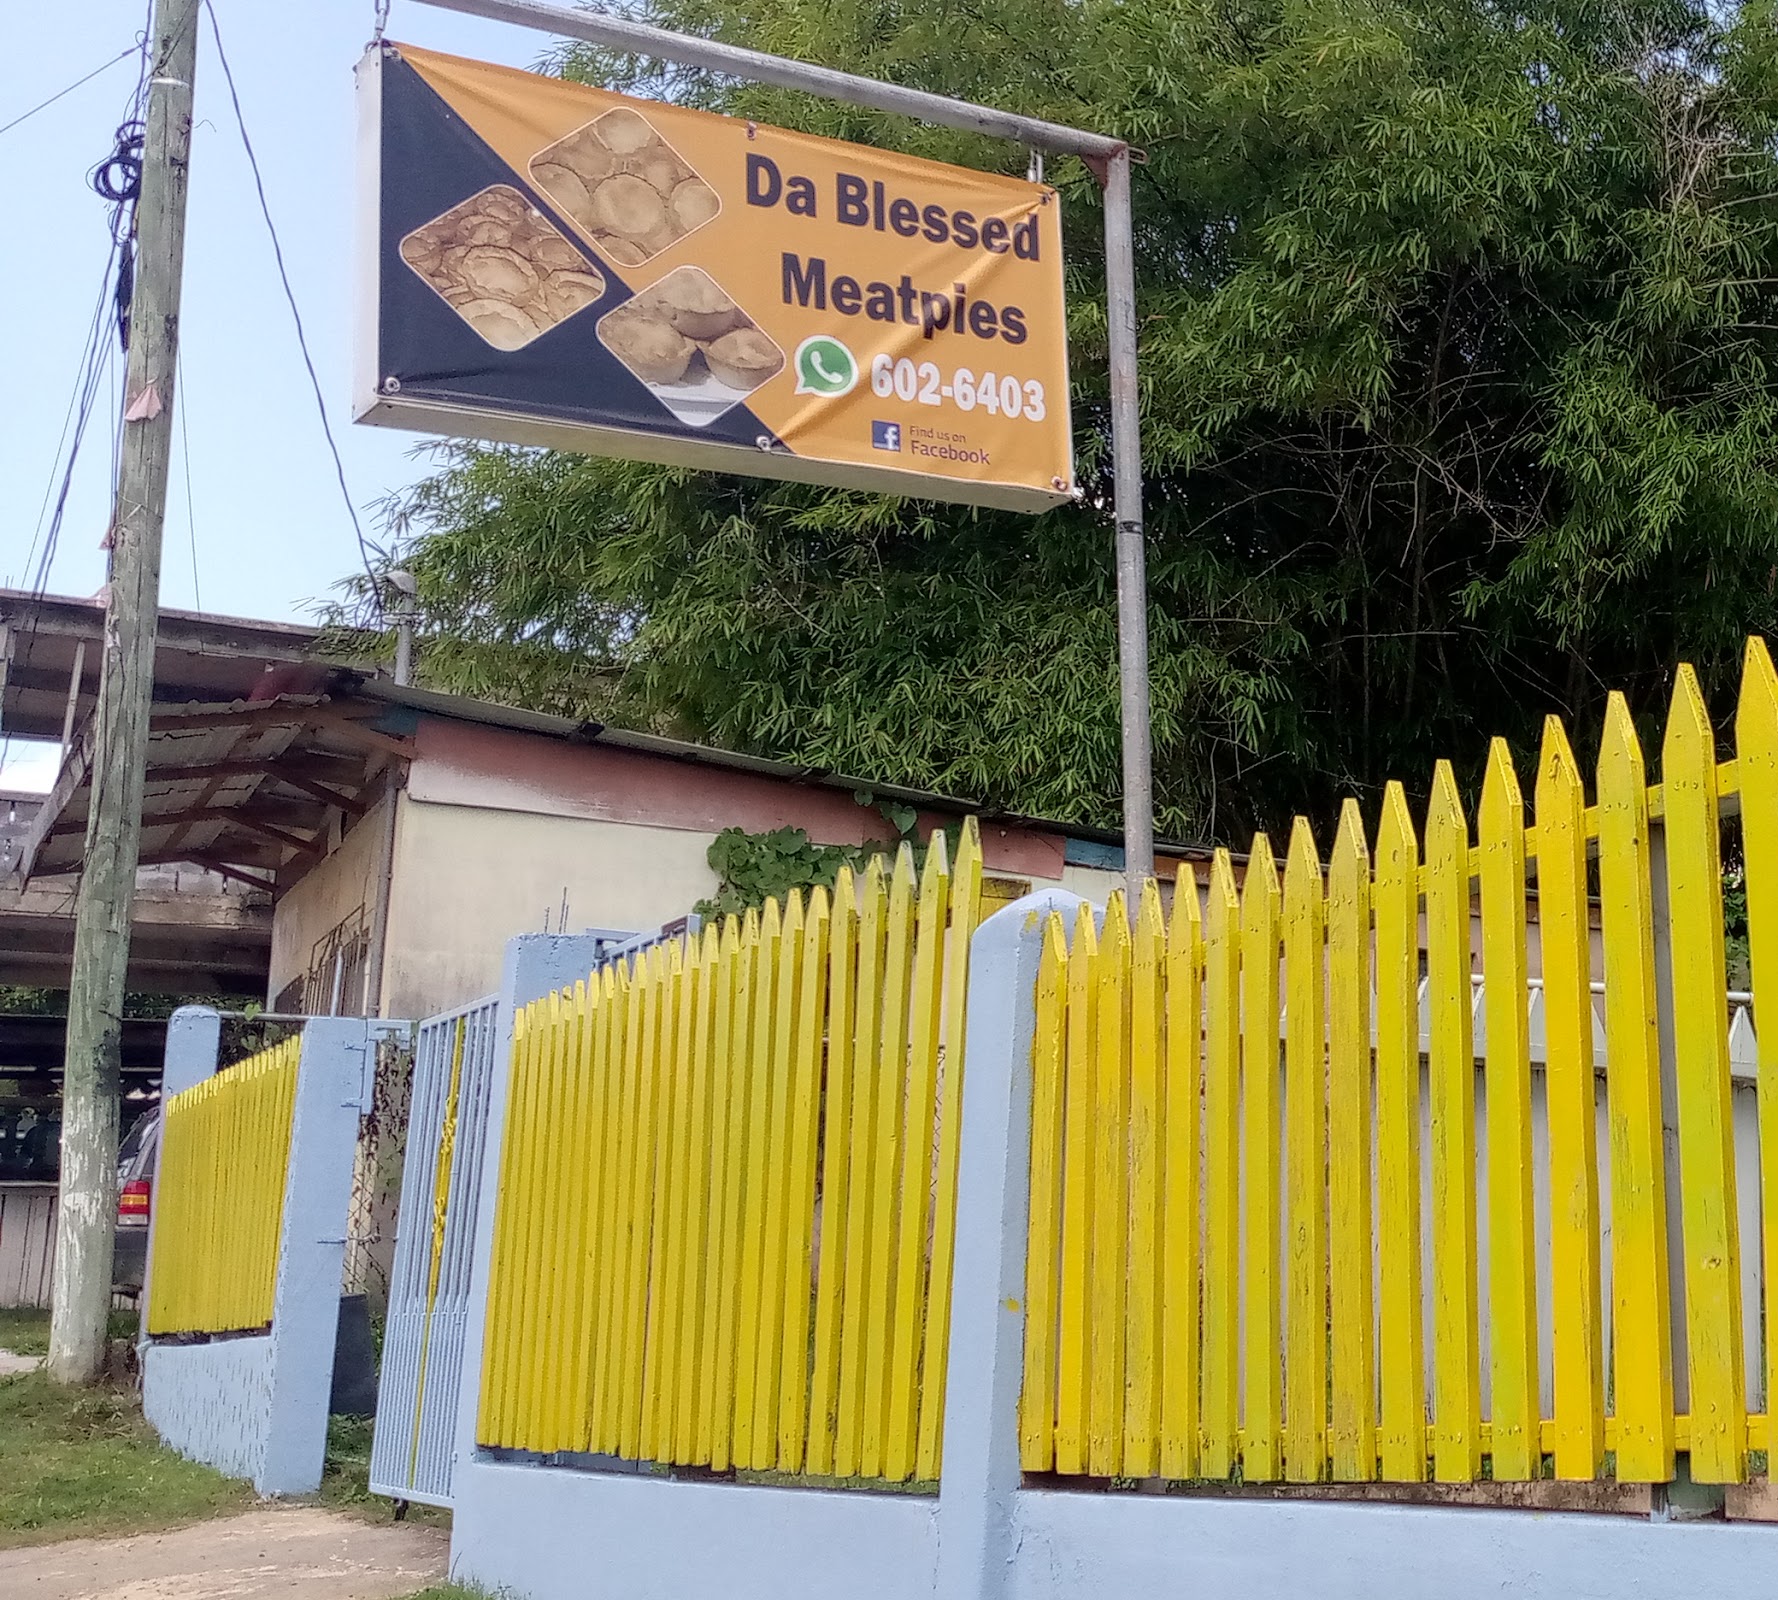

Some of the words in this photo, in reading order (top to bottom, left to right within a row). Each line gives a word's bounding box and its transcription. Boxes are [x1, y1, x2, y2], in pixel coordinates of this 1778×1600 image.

[745, 151, 818, 217] Da
[835, 172, 1042, 262] Blessed
[780, 251, 1029, 345] Meatpies
[871, 353, 1046, 422] 602-6403
[909, 425, 934, 439] Find
[938, 430, 950, 441] us
[952, 432, 966, 443] on
[910, 440, 991, 465] Facebook
